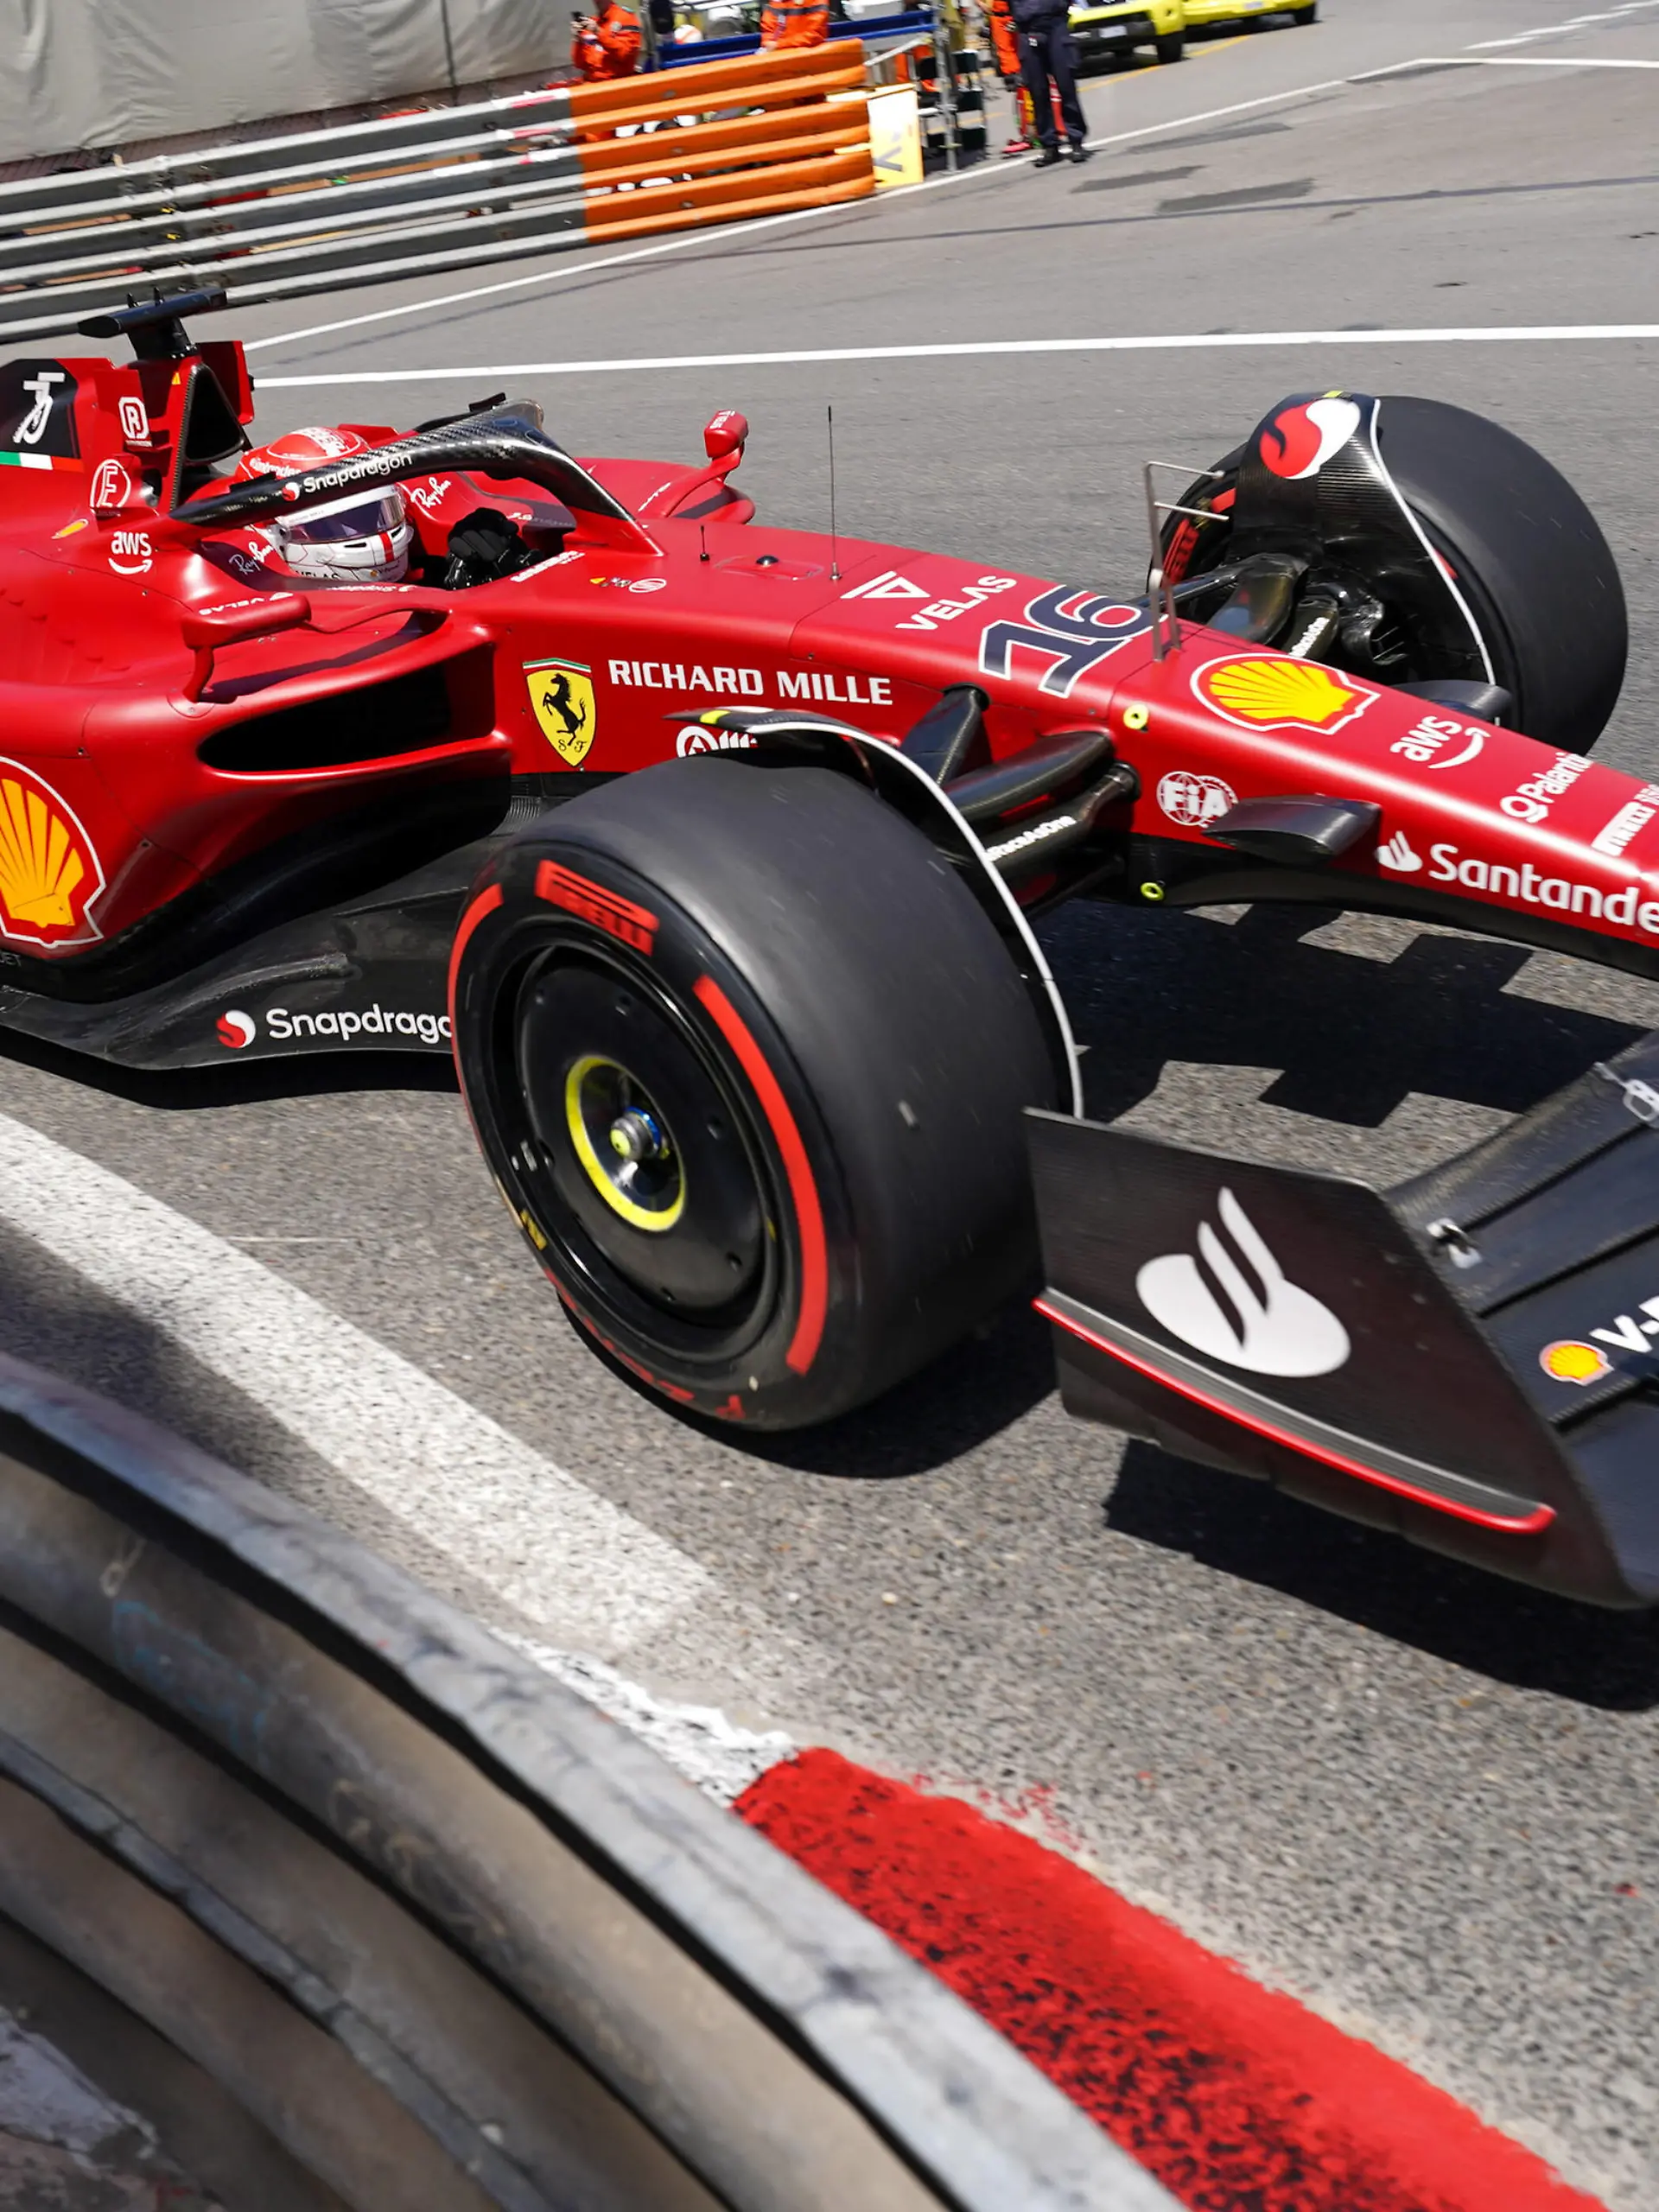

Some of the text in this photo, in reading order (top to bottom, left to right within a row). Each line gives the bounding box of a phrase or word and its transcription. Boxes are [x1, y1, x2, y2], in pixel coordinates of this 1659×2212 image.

[304, 452, 412, 493] Snapdragon
[111, 531, 152, 557] aws
[894, 575, 1017, 630] VELAS
[978, 584, 1169, 698] 16
[607, 659, 893, 706] RICHARD MILLE
[1389, 715, 1464, 762] aws
